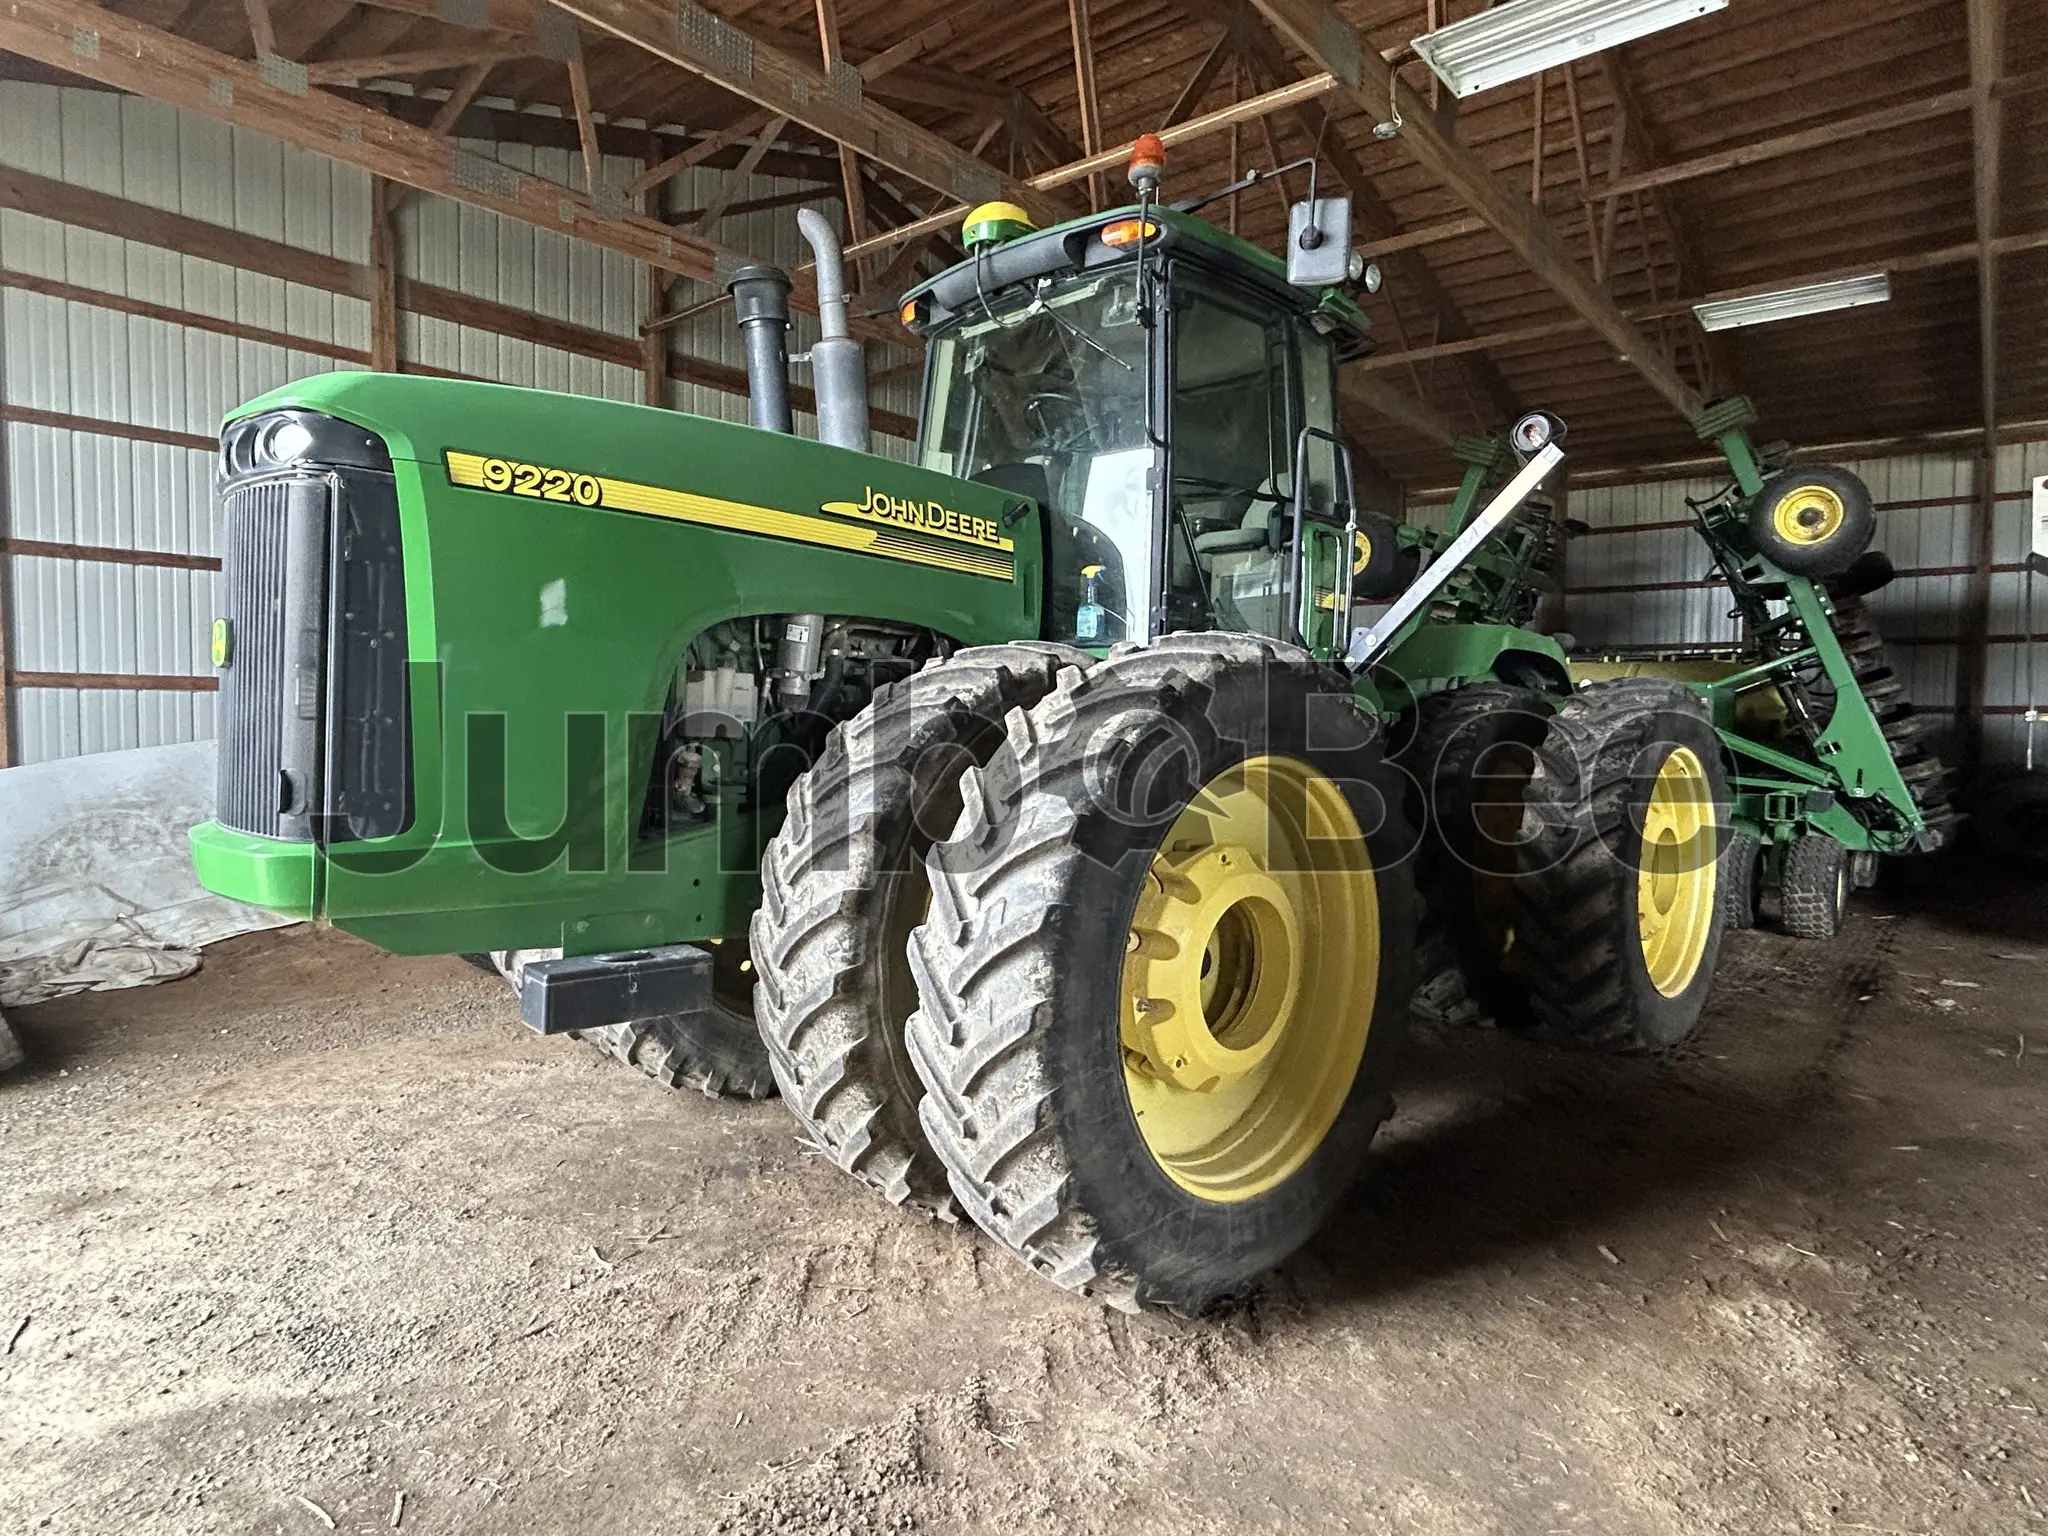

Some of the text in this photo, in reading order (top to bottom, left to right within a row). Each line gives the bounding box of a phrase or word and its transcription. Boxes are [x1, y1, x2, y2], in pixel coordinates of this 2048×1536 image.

[482, 458, 602, 507] 9220
[857, 485, 999, 542] JOHN DEERE
